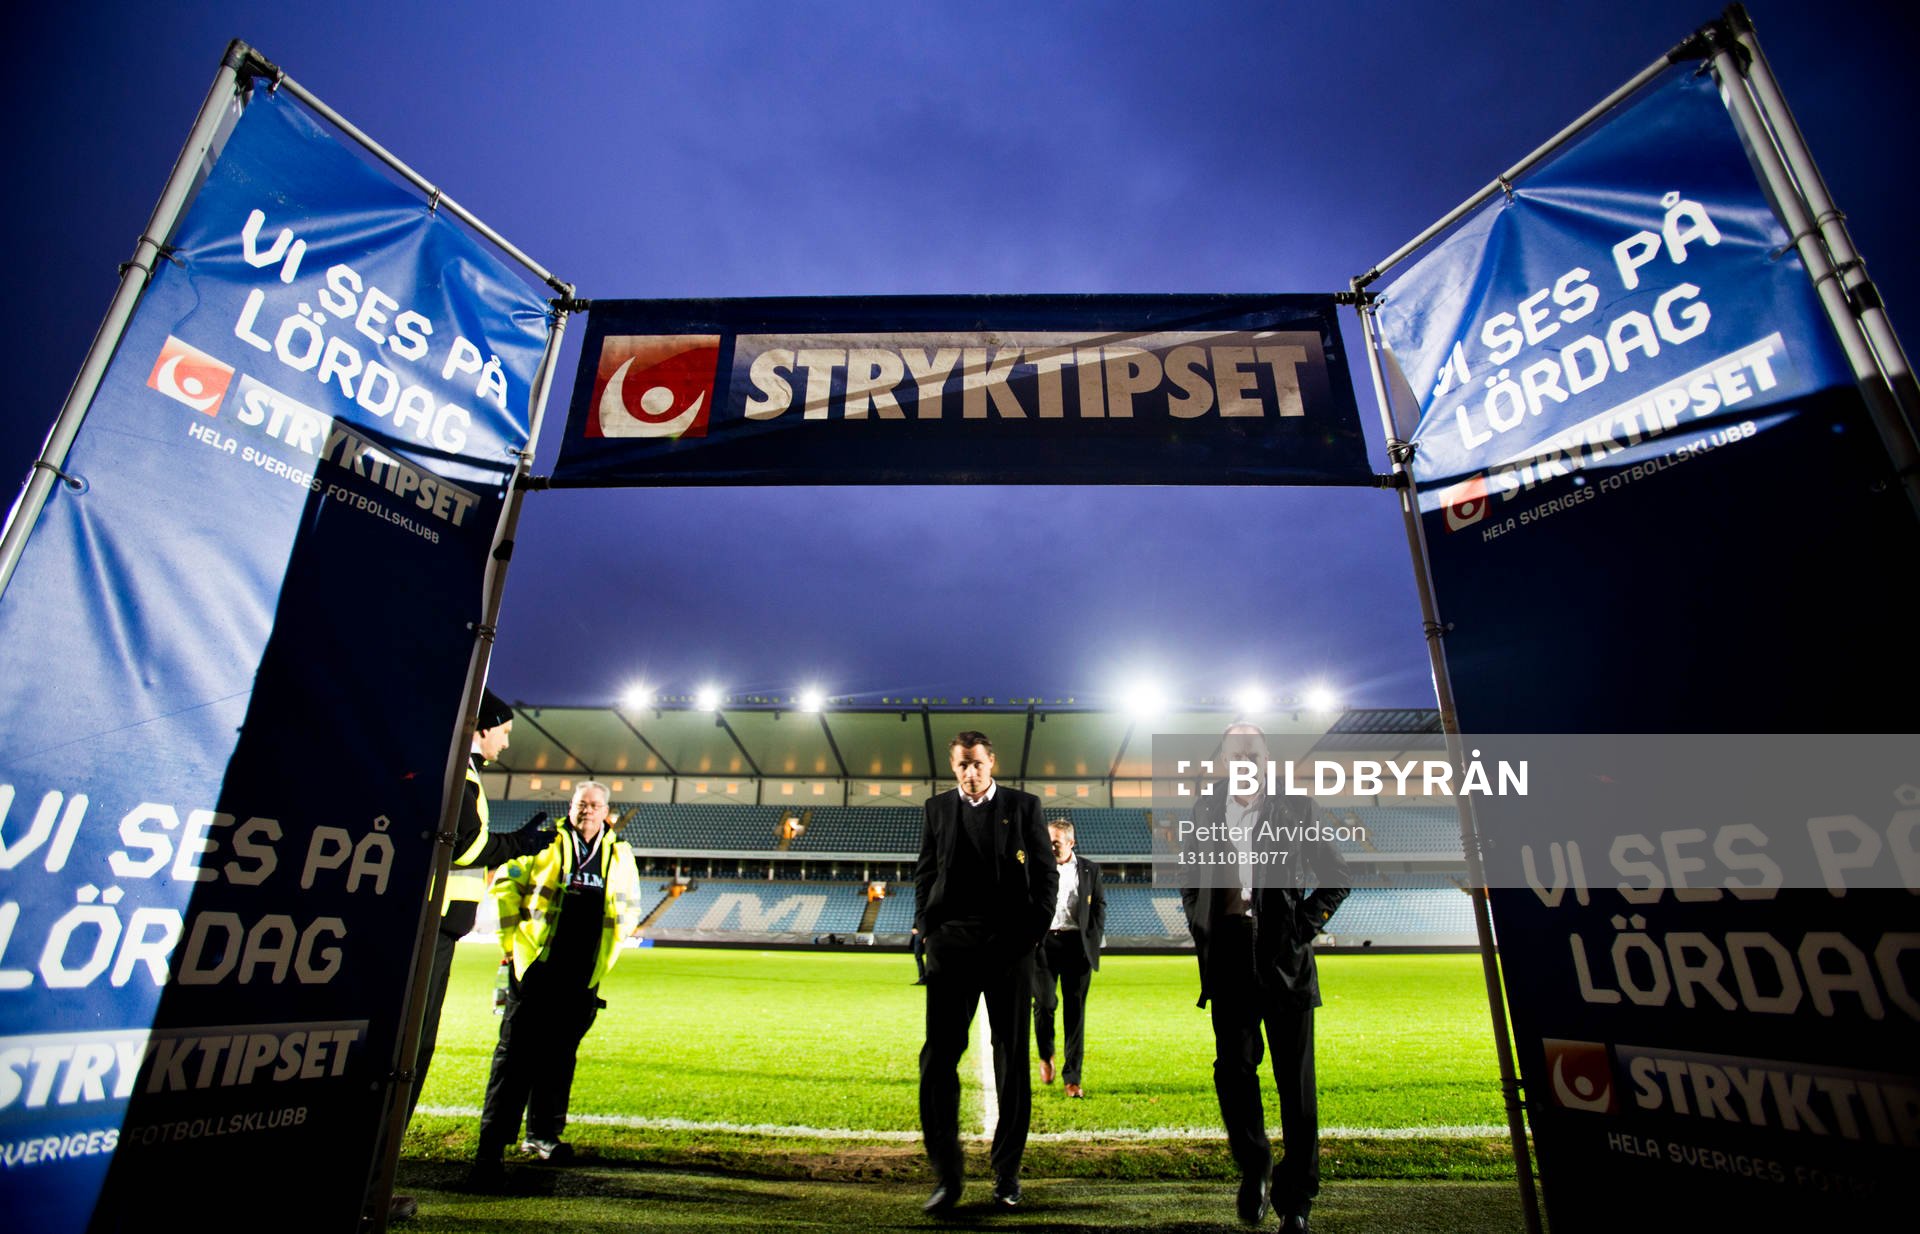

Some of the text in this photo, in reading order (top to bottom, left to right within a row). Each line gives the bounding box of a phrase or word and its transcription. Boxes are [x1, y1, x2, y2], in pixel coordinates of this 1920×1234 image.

[242, 208, 508, 409] VI SES PÅ
[1481, 266, 1600, 367] SES
[1612, 190, 1721, 291] PÅ
[234, 288, 471, 455] LÖRDAG
[743, 345, 1306, 421] STRYKTIPSET
[1456, 282, 1711, 450] LÖRDAG
[1499, 343, 1780, 502] STRYKTIPSET
[188, 421, 440, 544] HELA SVERIGES FOTBOLLSKLUBB
[237, 388, 473, 527] STRYKTIPSET
[1482, 420, 1758, 543] HELA SVERIGES FOTBOLLSKLUBB
[0, 784, 396, 895] VI SES PÅ
[1521, 840, 1591, 908] VI
[1608, 823, 1784, 906] SES
[0, 883, 347, 990] LÖRDAG
[696, 892, 828, 933] M
[129, 1106, 308, 1147] FOTBOLLSKLUBB
[1608, 1130, 1661, 1161] HELA
[1667, 1141, 1785, 1184] SVERIGES
